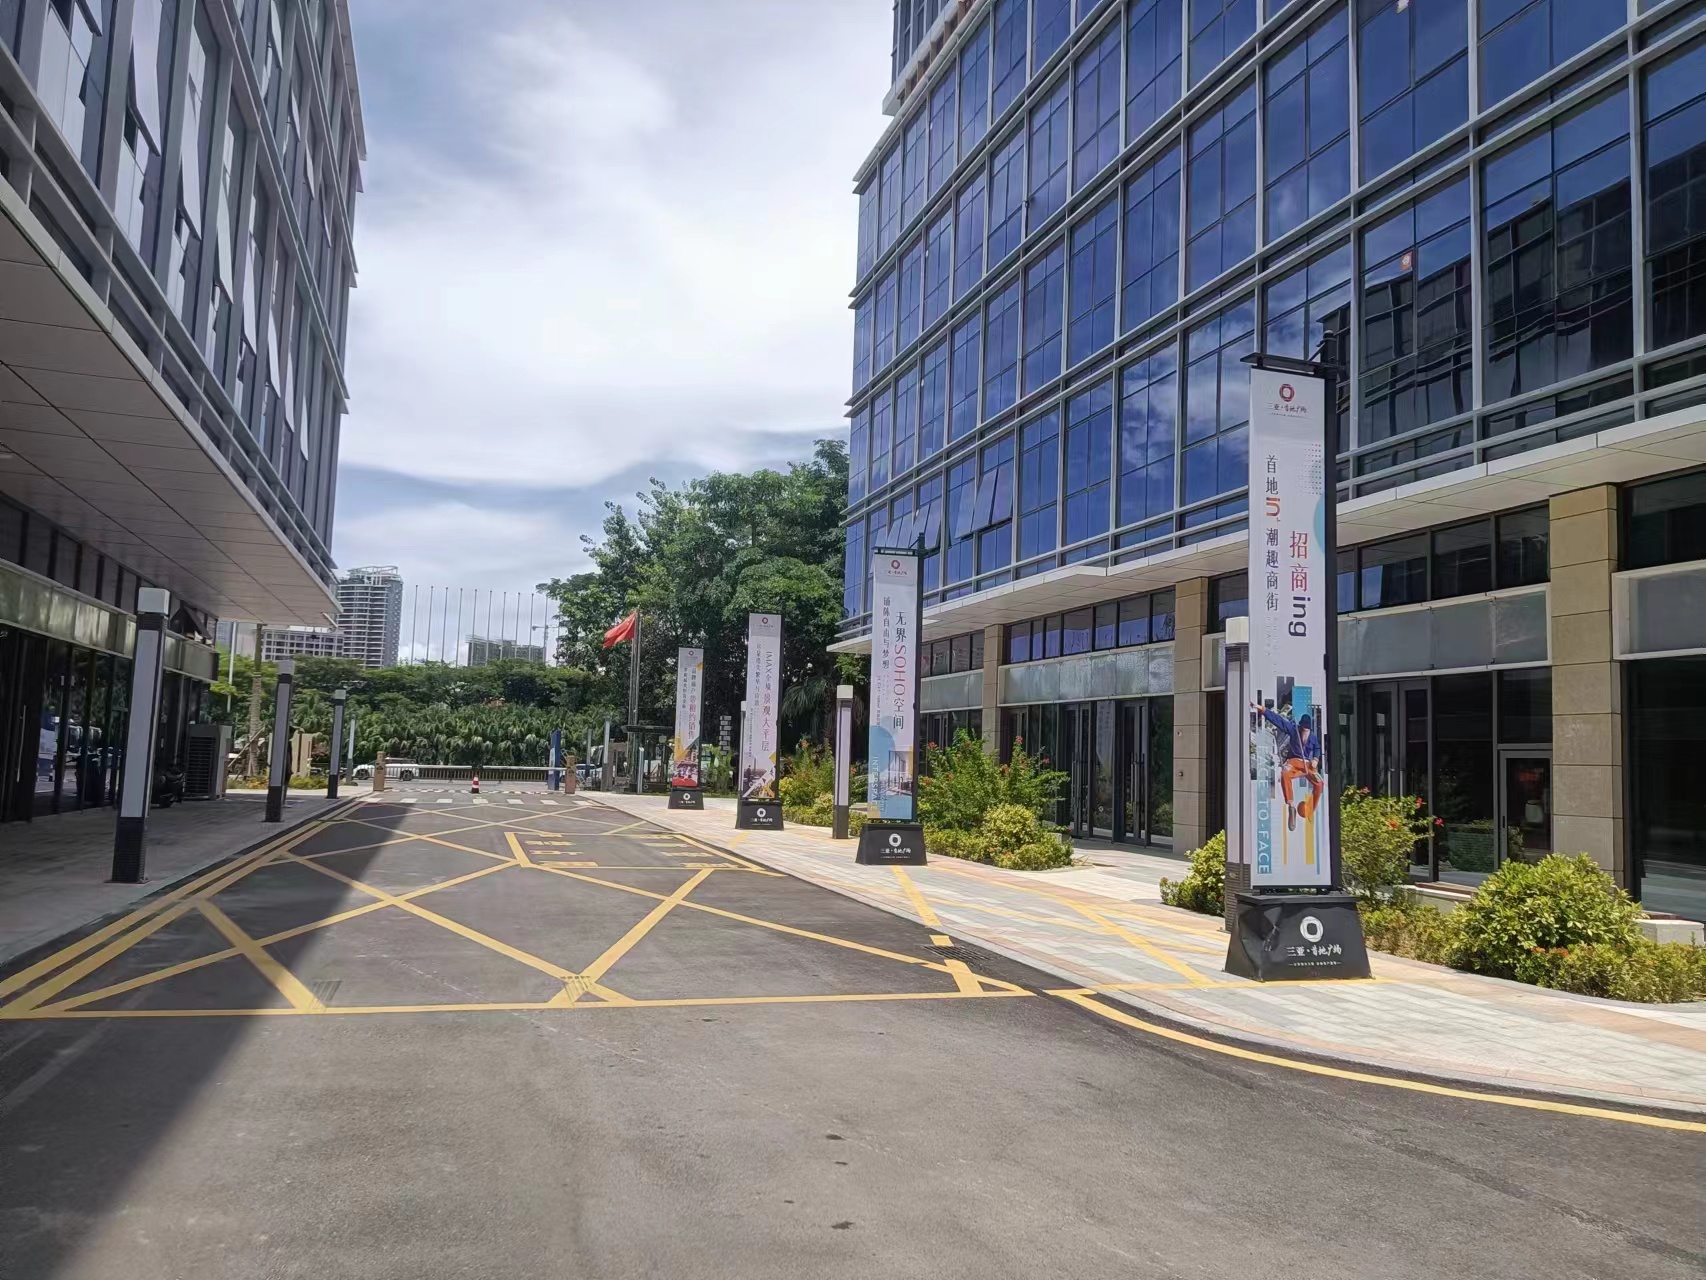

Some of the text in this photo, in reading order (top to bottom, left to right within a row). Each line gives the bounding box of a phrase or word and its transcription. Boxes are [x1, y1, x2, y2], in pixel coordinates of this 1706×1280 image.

[1288, 531, 1311, 638] 招商ing
[893, 611, 907, 730] 无界SOHO空间
